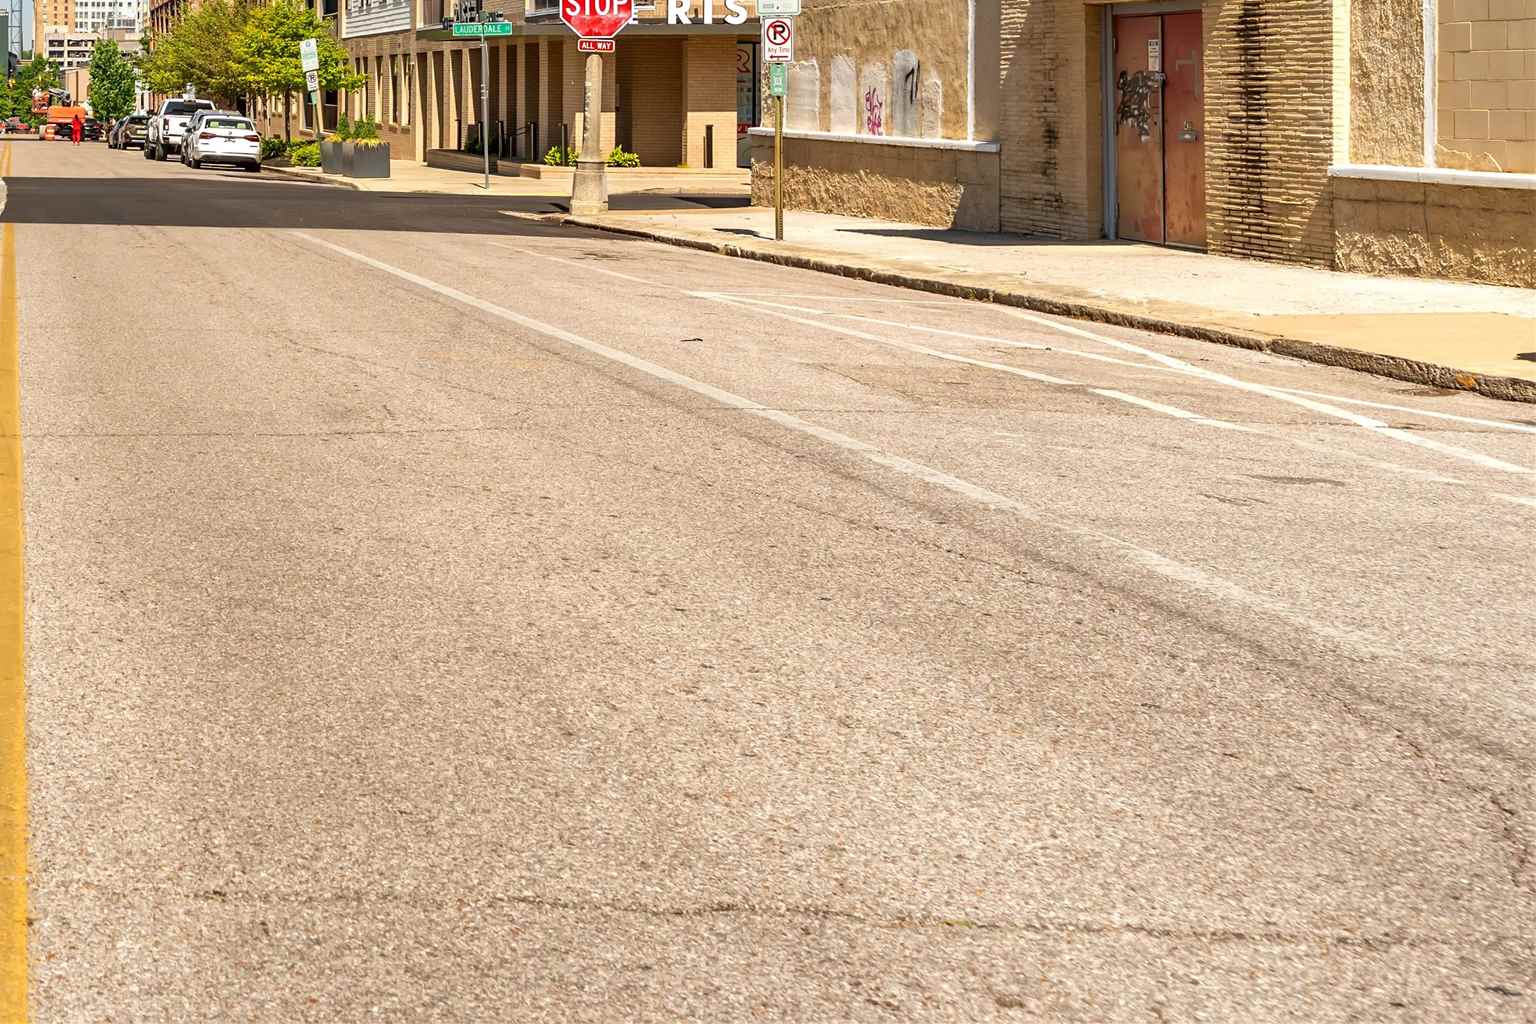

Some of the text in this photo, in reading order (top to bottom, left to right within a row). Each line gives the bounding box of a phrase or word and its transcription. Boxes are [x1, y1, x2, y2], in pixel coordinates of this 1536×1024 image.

[455, 24, 502, 34] LAUDERDALE
[581, 41, 612, 51] ALL WAY
